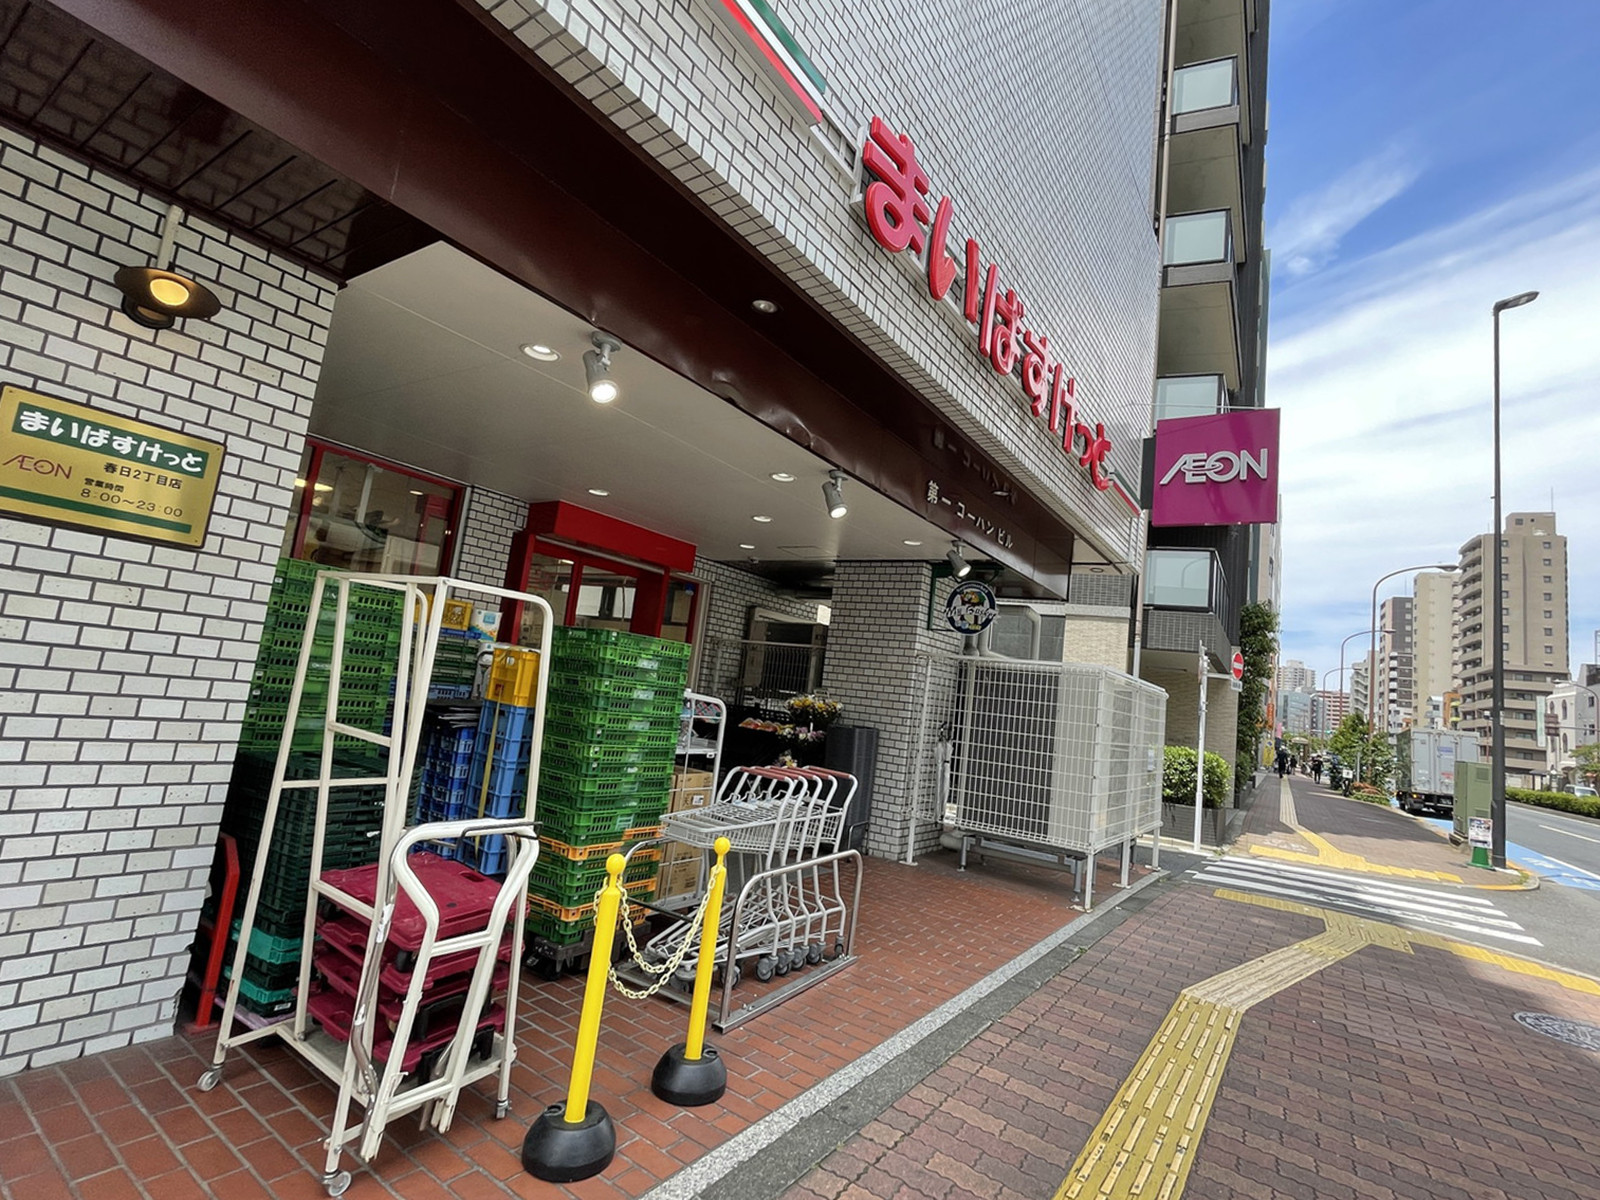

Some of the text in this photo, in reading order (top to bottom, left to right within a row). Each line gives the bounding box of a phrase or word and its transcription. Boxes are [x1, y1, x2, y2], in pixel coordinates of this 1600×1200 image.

[863, 115, 1112, 490] まいばすけっと
[20, 410, 204, 473] まいばすけっと
[84, 478, 125, 493] 営業時間
[104, 462, 183, 490] 春日2丁目店
